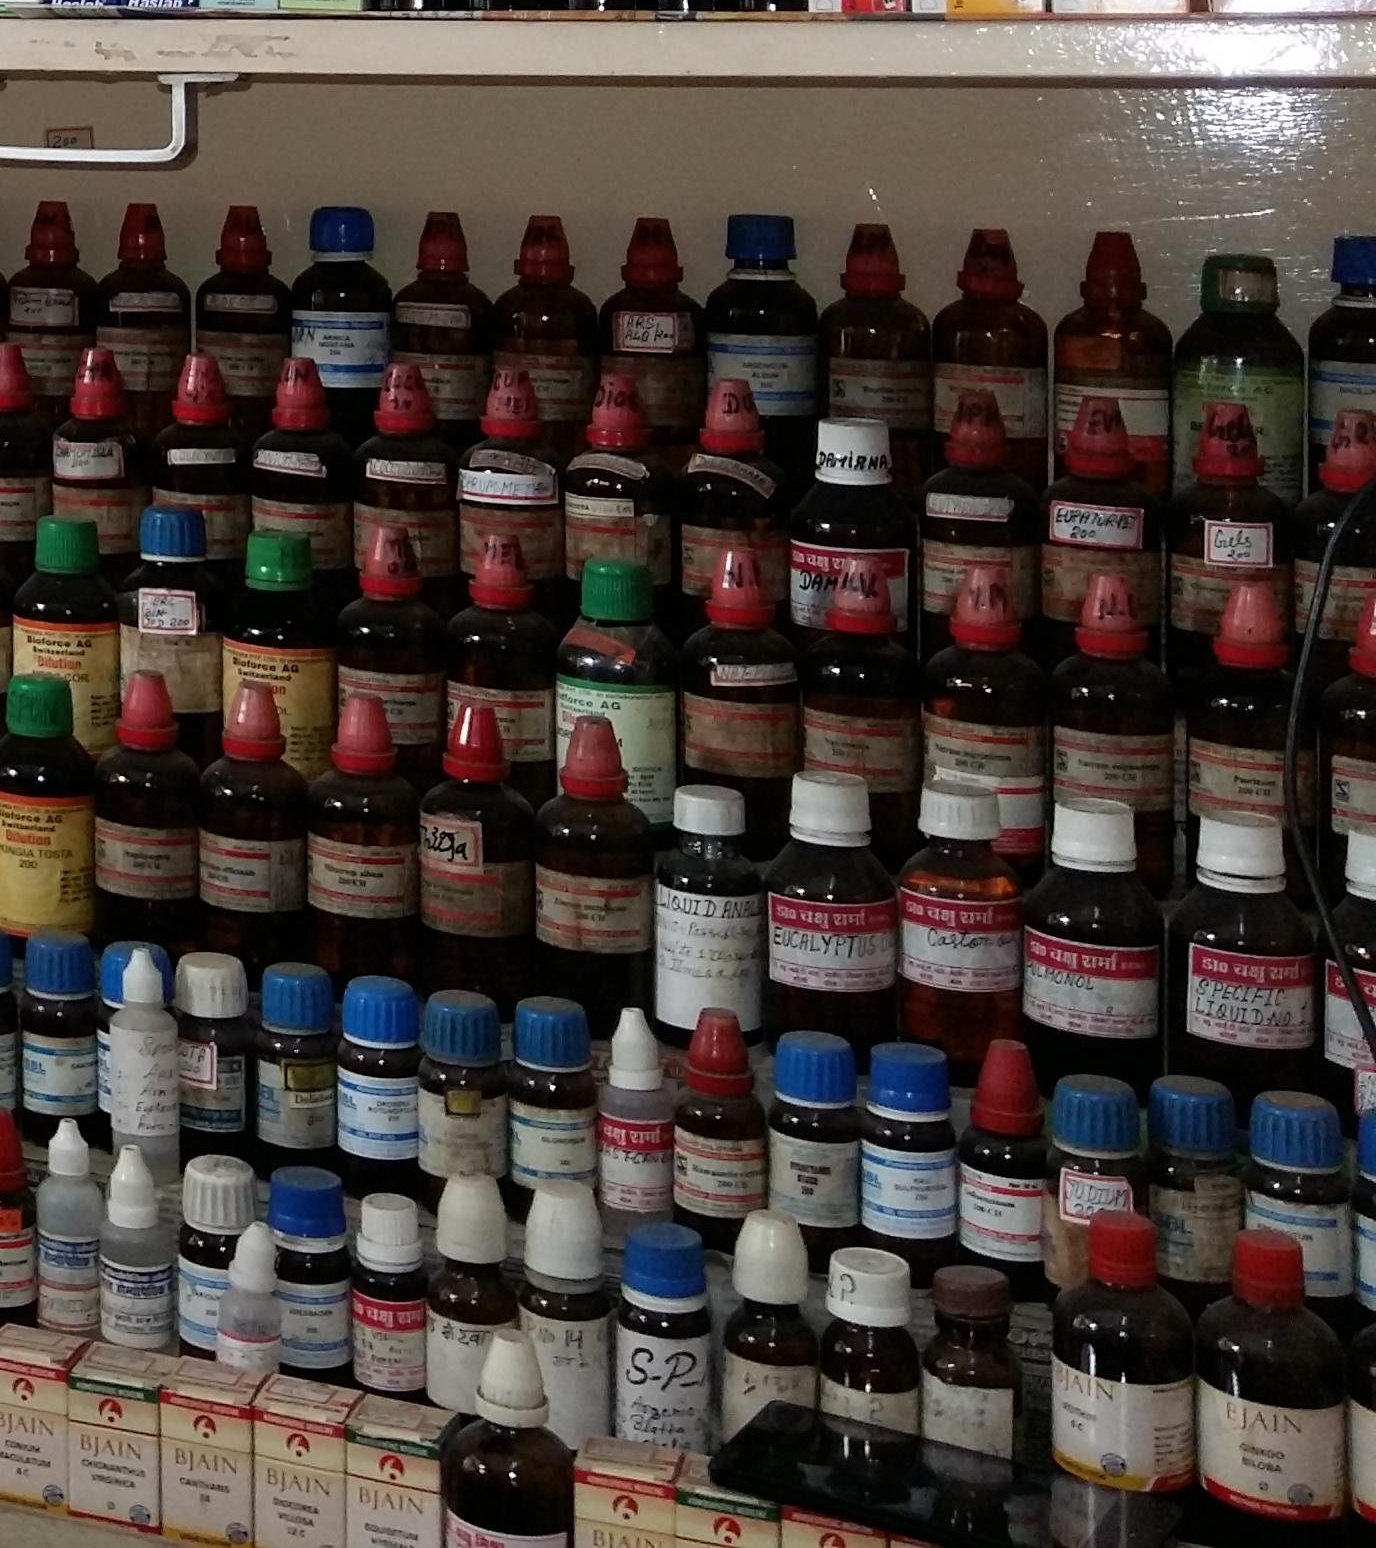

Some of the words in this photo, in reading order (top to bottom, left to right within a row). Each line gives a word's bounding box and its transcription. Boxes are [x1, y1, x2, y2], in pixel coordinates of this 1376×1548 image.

[37, 657, 82, 670] Dilution
[45, 814, 63, 824] AG
[1, 820, 56, 832] Switzerland
[6, 830, 51, 845] Dilution
[19, 858, 38, 869] 200
